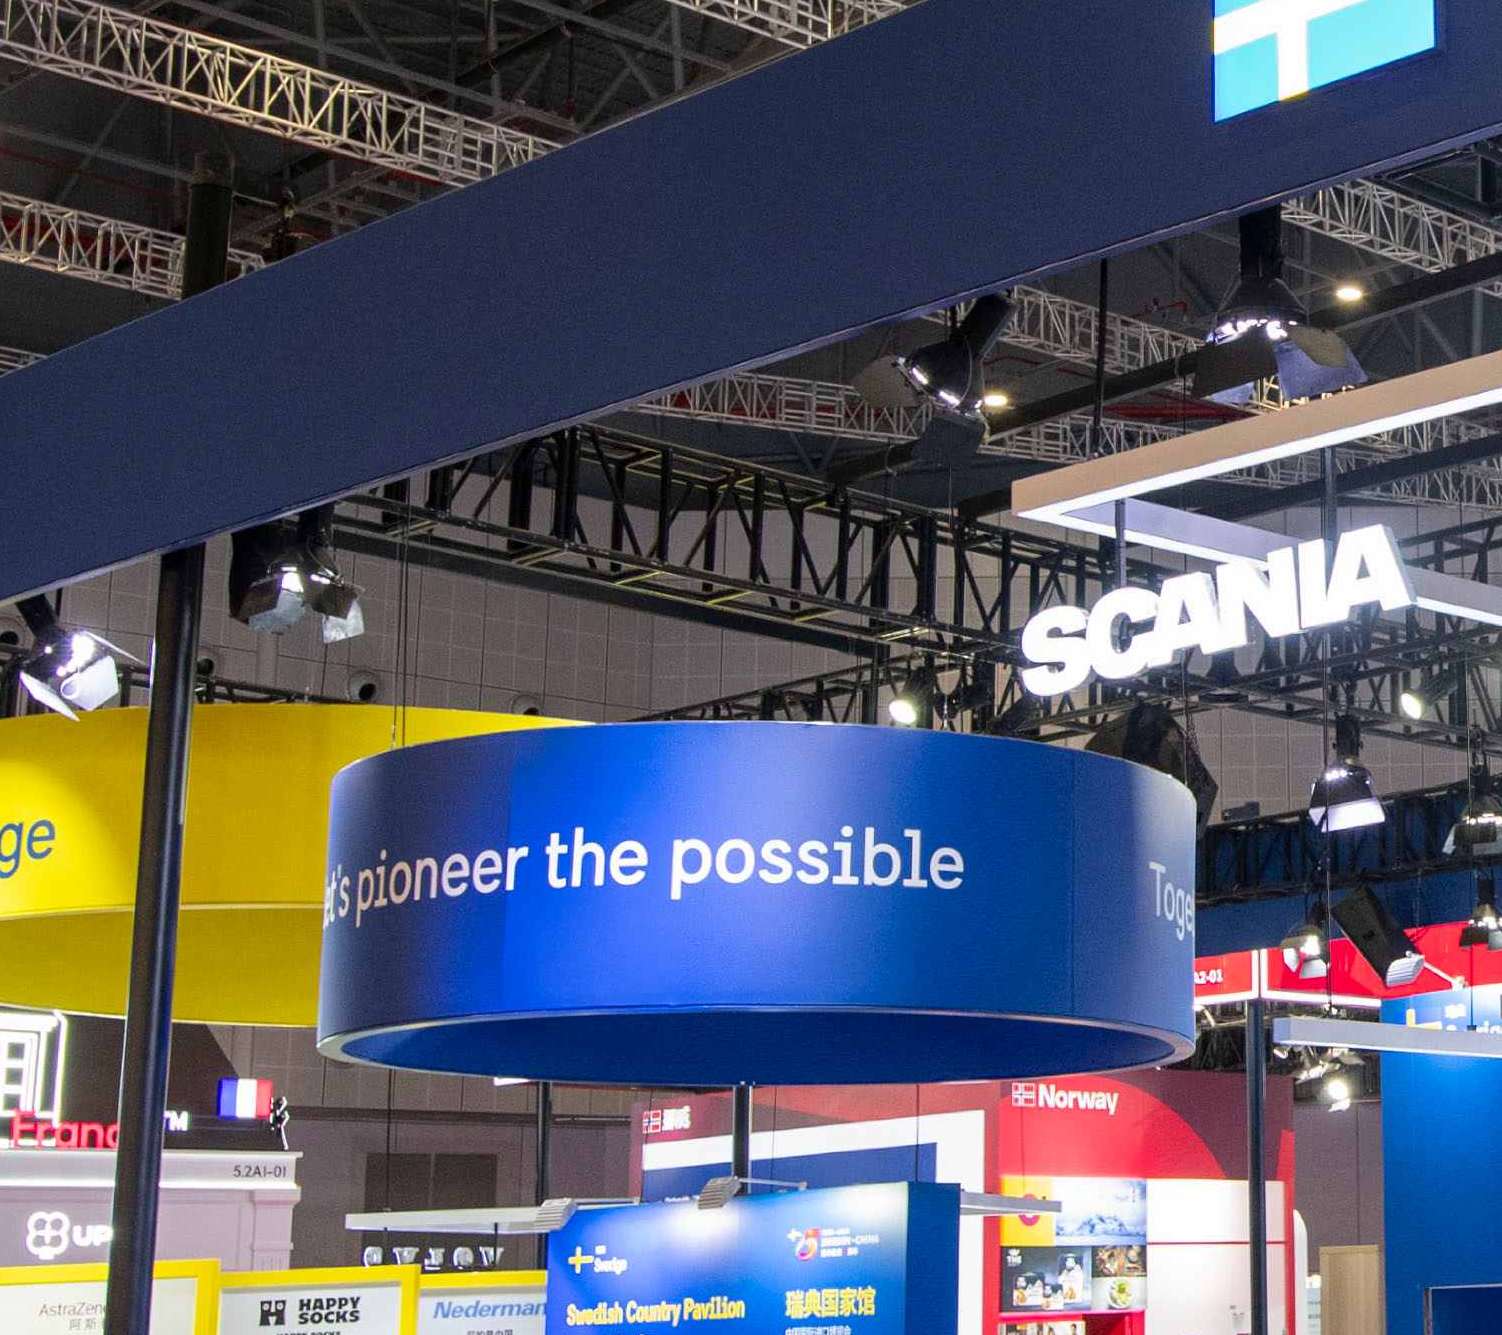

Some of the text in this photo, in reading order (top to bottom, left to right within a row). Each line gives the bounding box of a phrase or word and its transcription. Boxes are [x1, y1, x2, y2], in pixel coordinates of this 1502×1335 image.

[1020, 523, 1417, 697] SCANIA
[356, 849, 528, 928] pioneer
[545, 826, 648, 890] the
[670, 825, 965, 900] possible
[1149, 861, 1195, 941] Toge
[1038, 1083, 1119, 1115] Norway
[233, 1165, 287, 1178] 5.2A1-01
[298, 1296, 361, 1311] HAPPY
[298, 1309, 361, 1325] SOCKS
[433, 1298, 546, 1320] Nederman
[567, 1296, 746, 1327] Swedish Country Pavilion
